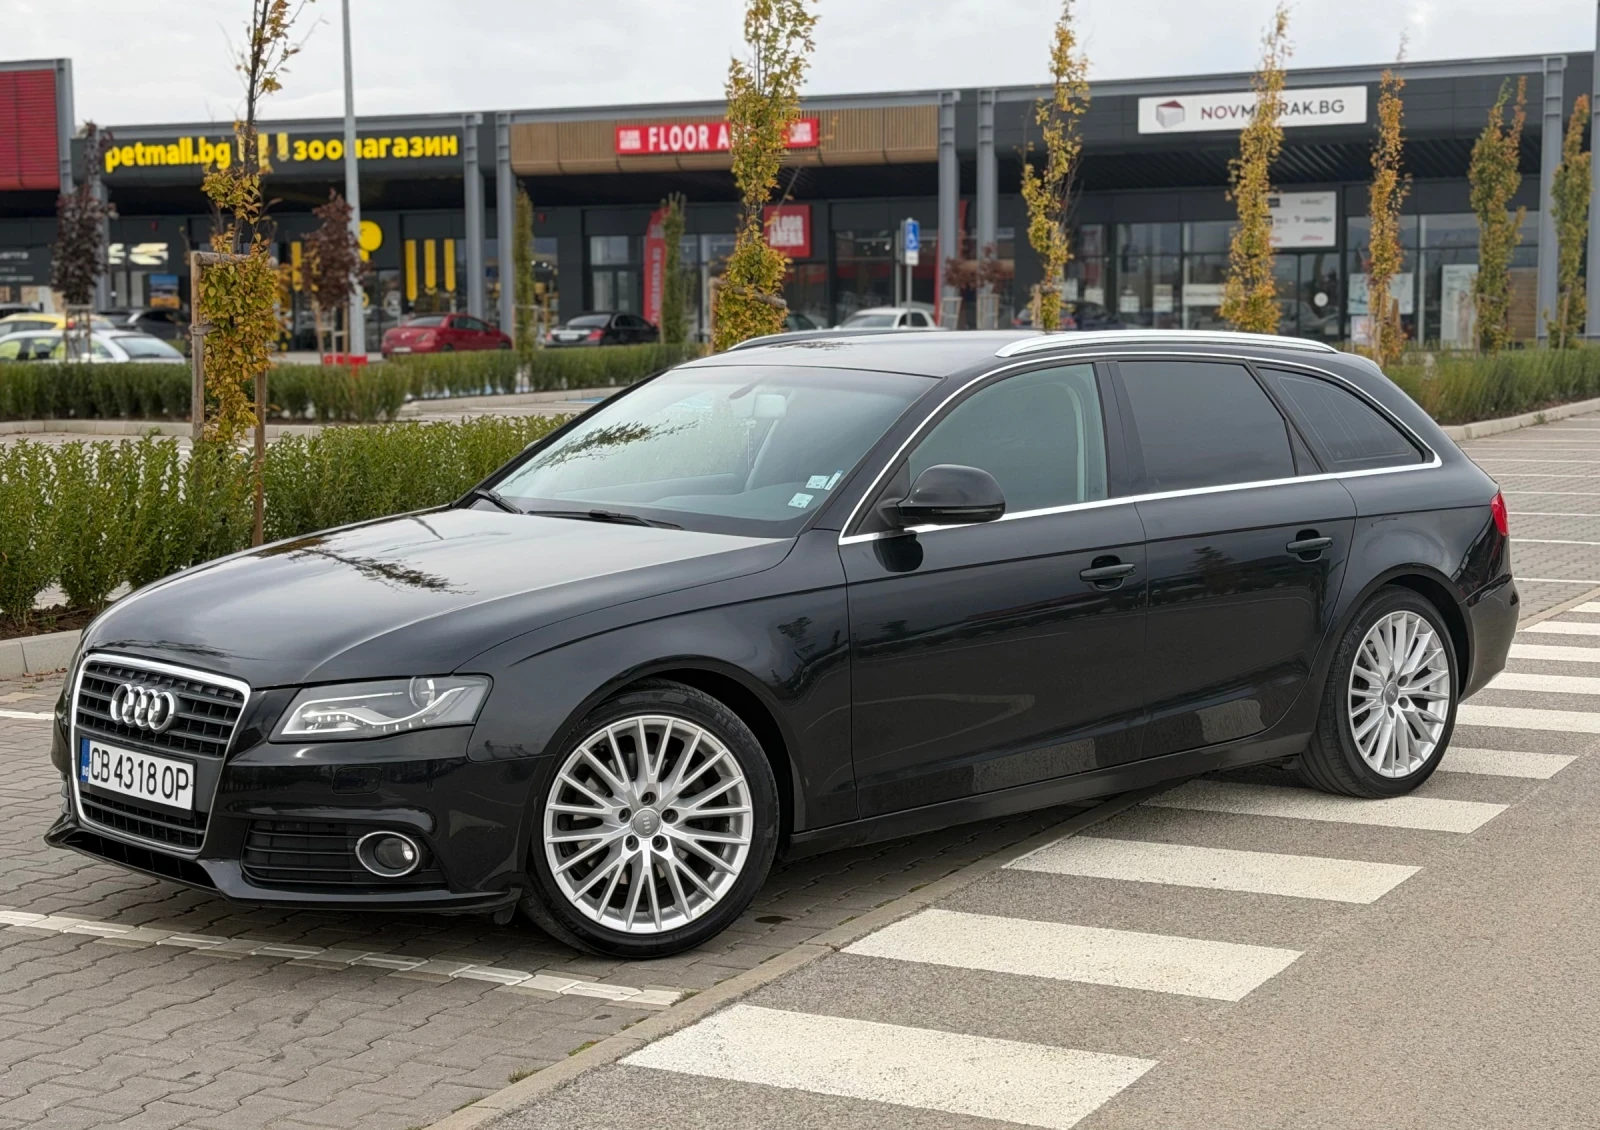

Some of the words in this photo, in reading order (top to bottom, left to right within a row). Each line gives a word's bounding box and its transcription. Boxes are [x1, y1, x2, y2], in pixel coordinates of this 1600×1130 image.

[1201, 100, 1344, 120] NOVMRAK.BG
[649, 126, 709, 151] FLOOR
[105, 136, 231, 173] petmall.bg
[91, 747, 110, 782] CB
[114, 754, 157, 795] 4318
[161, 765, 189, 801] OP
